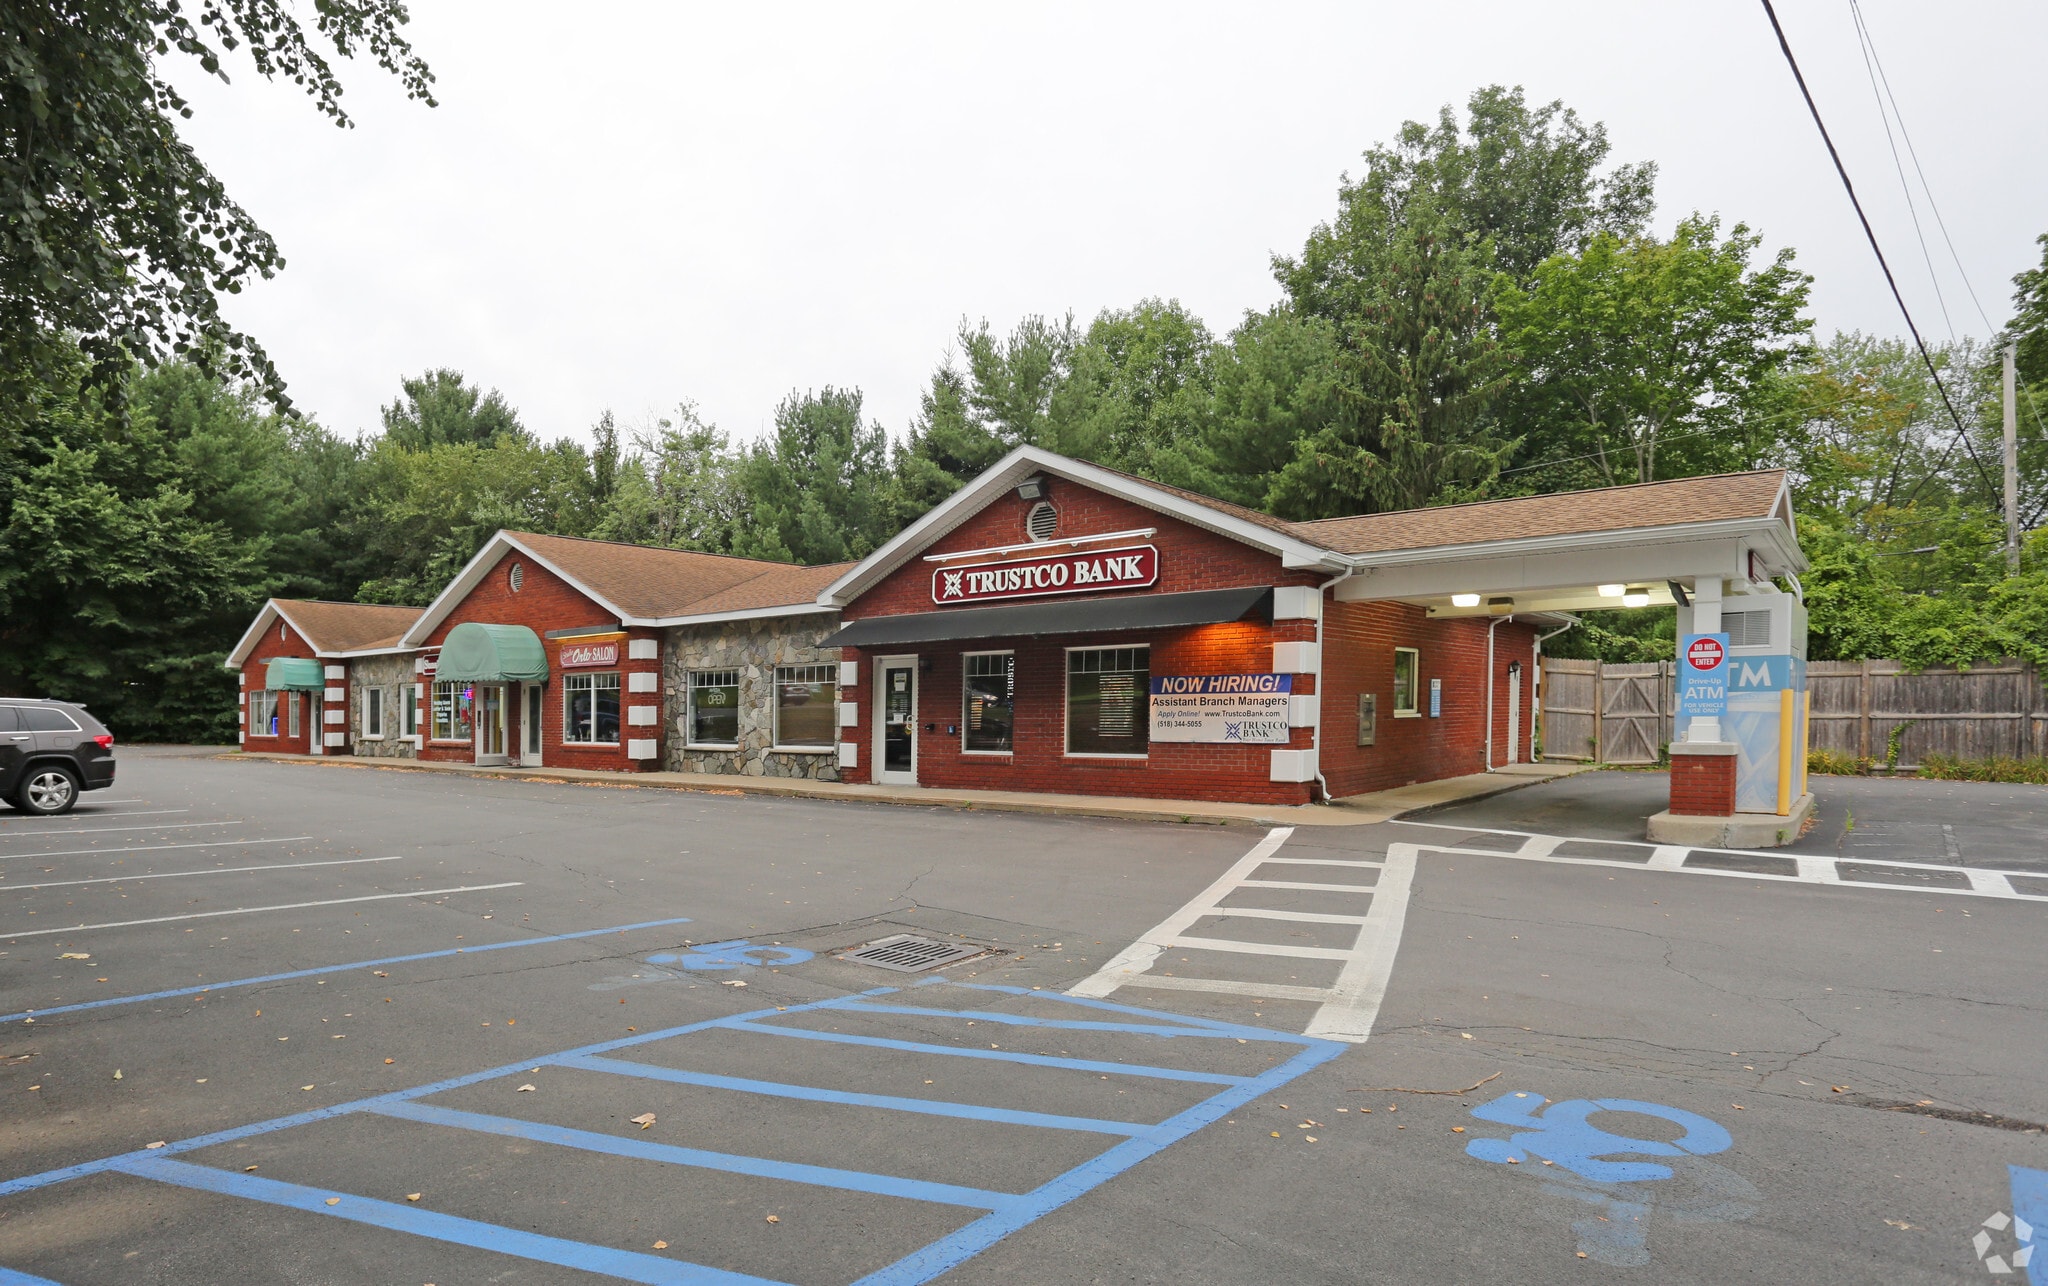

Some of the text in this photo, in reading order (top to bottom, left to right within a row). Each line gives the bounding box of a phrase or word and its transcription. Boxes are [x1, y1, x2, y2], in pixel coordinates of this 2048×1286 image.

[966, 555, 1144, 594] TRUSTCO BANK
[1694, 643, 1703, 651] DO
[592, 646, 615, 661] SALON
[1695, 658, 1715, 666] ENTER
[1161, 675, 1281, 693] NOW HIRING!
[1684, 686, 1724, 699] ATM
[707, 691, 726, 705] OPEN
[1152, 696, 1288, 707] Assistant Branch Managers
[1157, 711, 1176, 719] Apply
[1157, 720, 1173, 729] (518)
[1241, 721, 1288, 730] TRUSTCO
[1243, 729, 1270, 738] BANK
